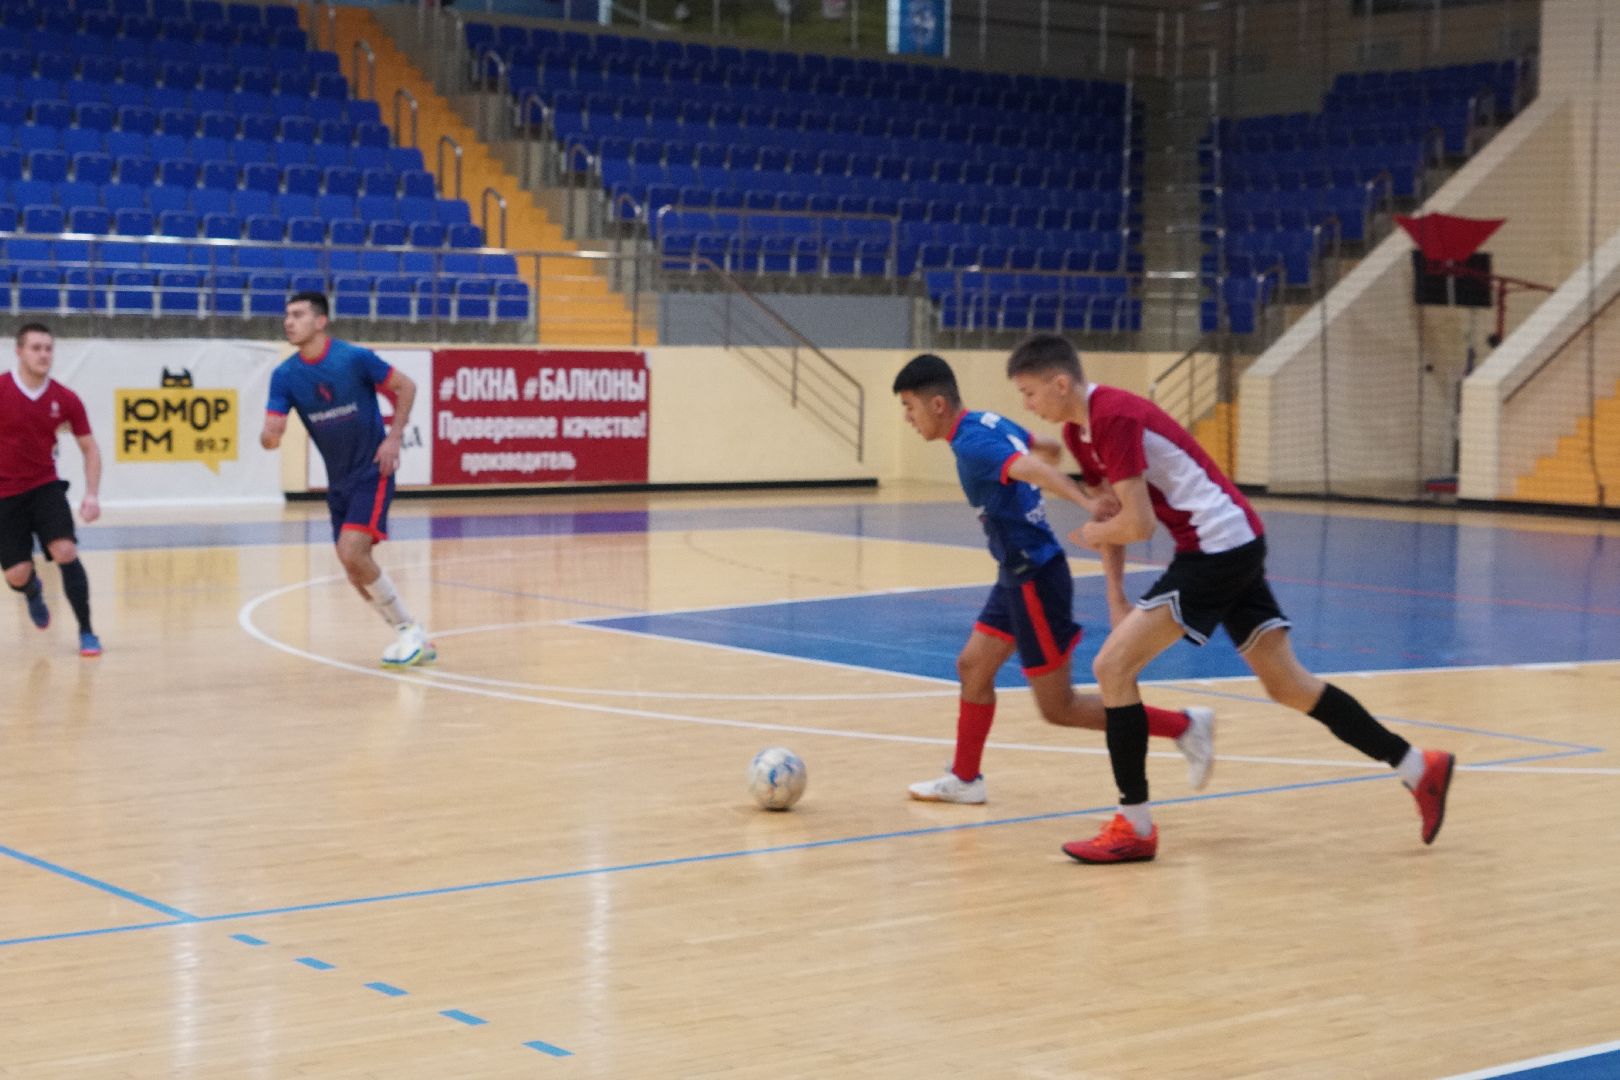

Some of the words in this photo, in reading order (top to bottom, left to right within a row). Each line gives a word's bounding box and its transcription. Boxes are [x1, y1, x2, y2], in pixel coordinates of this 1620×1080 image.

[438, 367, 519, 401] #ОКНА
[523, 367, 646, 402] #БАЛКОНЫ
[123, 396, 230, 431] ЮМОР
[438, 410, 558, 444] Проверенное
[124, 428, 173, 453] FM
[195, 437, 230, 453] 89.7
